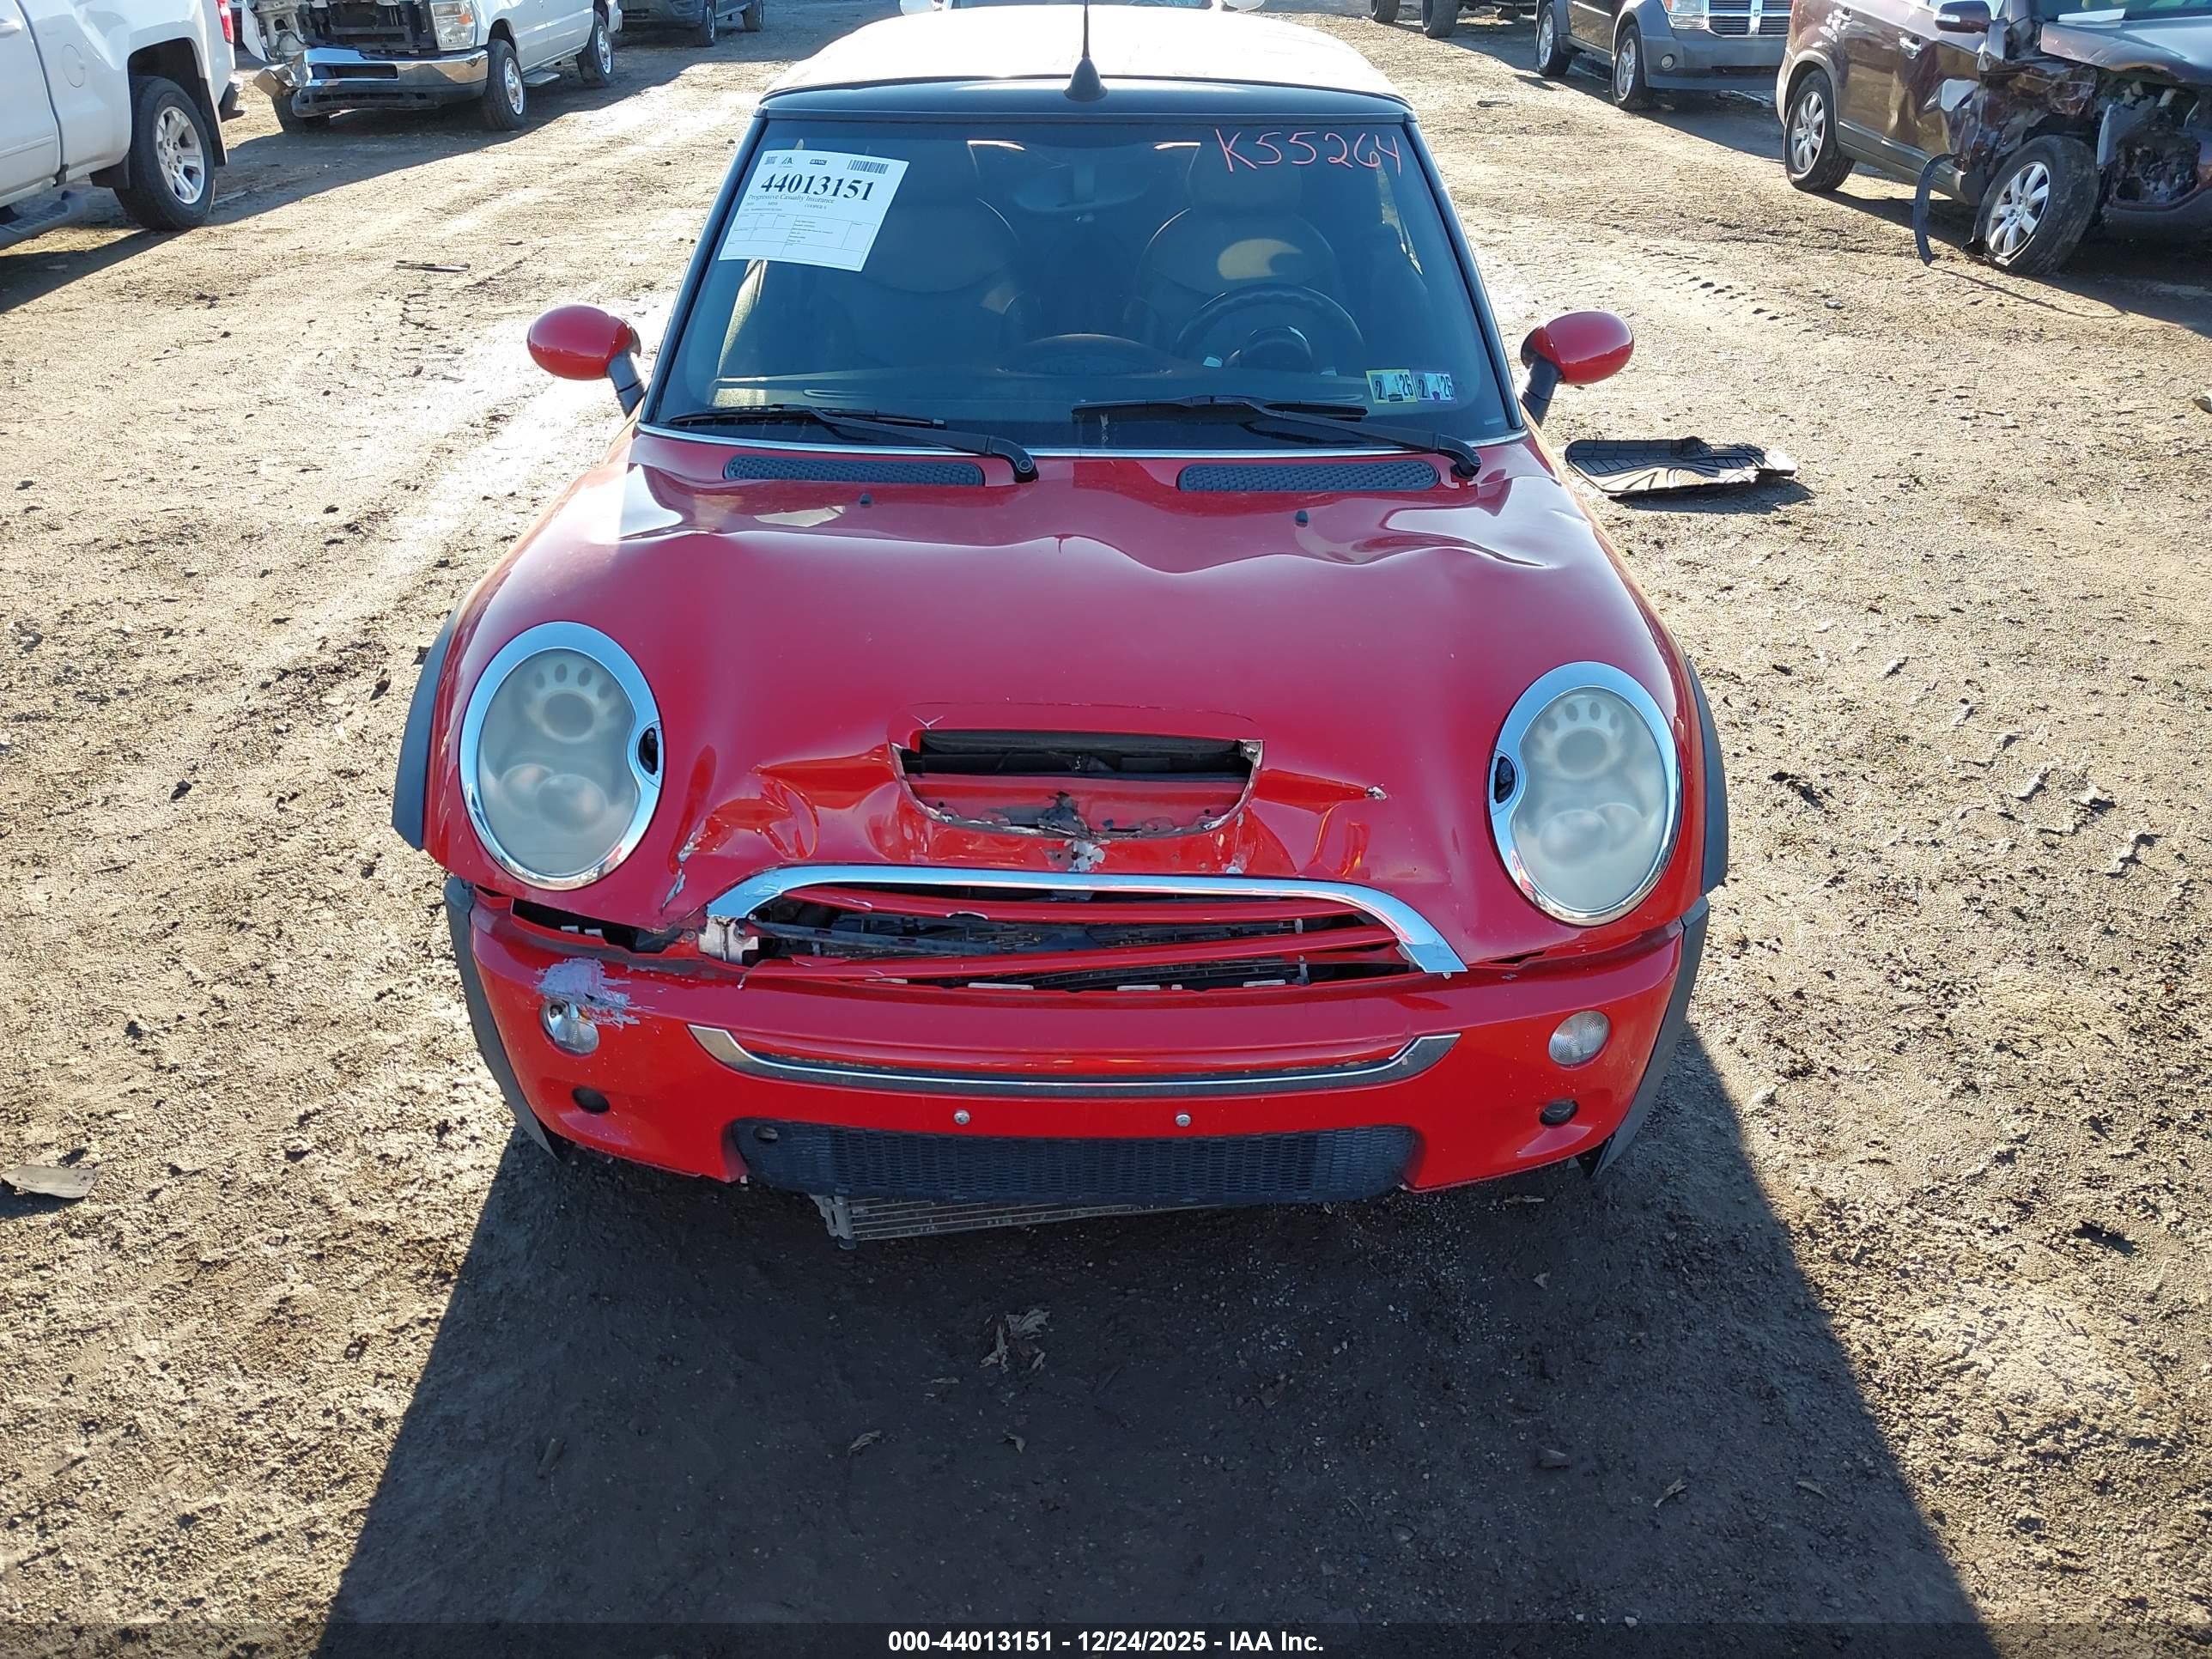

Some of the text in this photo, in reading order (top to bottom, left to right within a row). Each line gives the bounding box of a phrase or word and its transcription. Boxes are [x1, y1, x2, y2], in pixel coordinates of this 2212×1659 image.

[1215, 128, 1402, 176] K55264
[761, 173, 875, 202] 44013151
[780, 193, 805, 203] Casualty
[805, 195, 836, 204] Insurance
[1375, 380, 1384, 399] 2
[1399, 374, 1413, 397] 26
[1419, 379, 1428, 398] 2
[1440, 376, 1454, 398] 26
